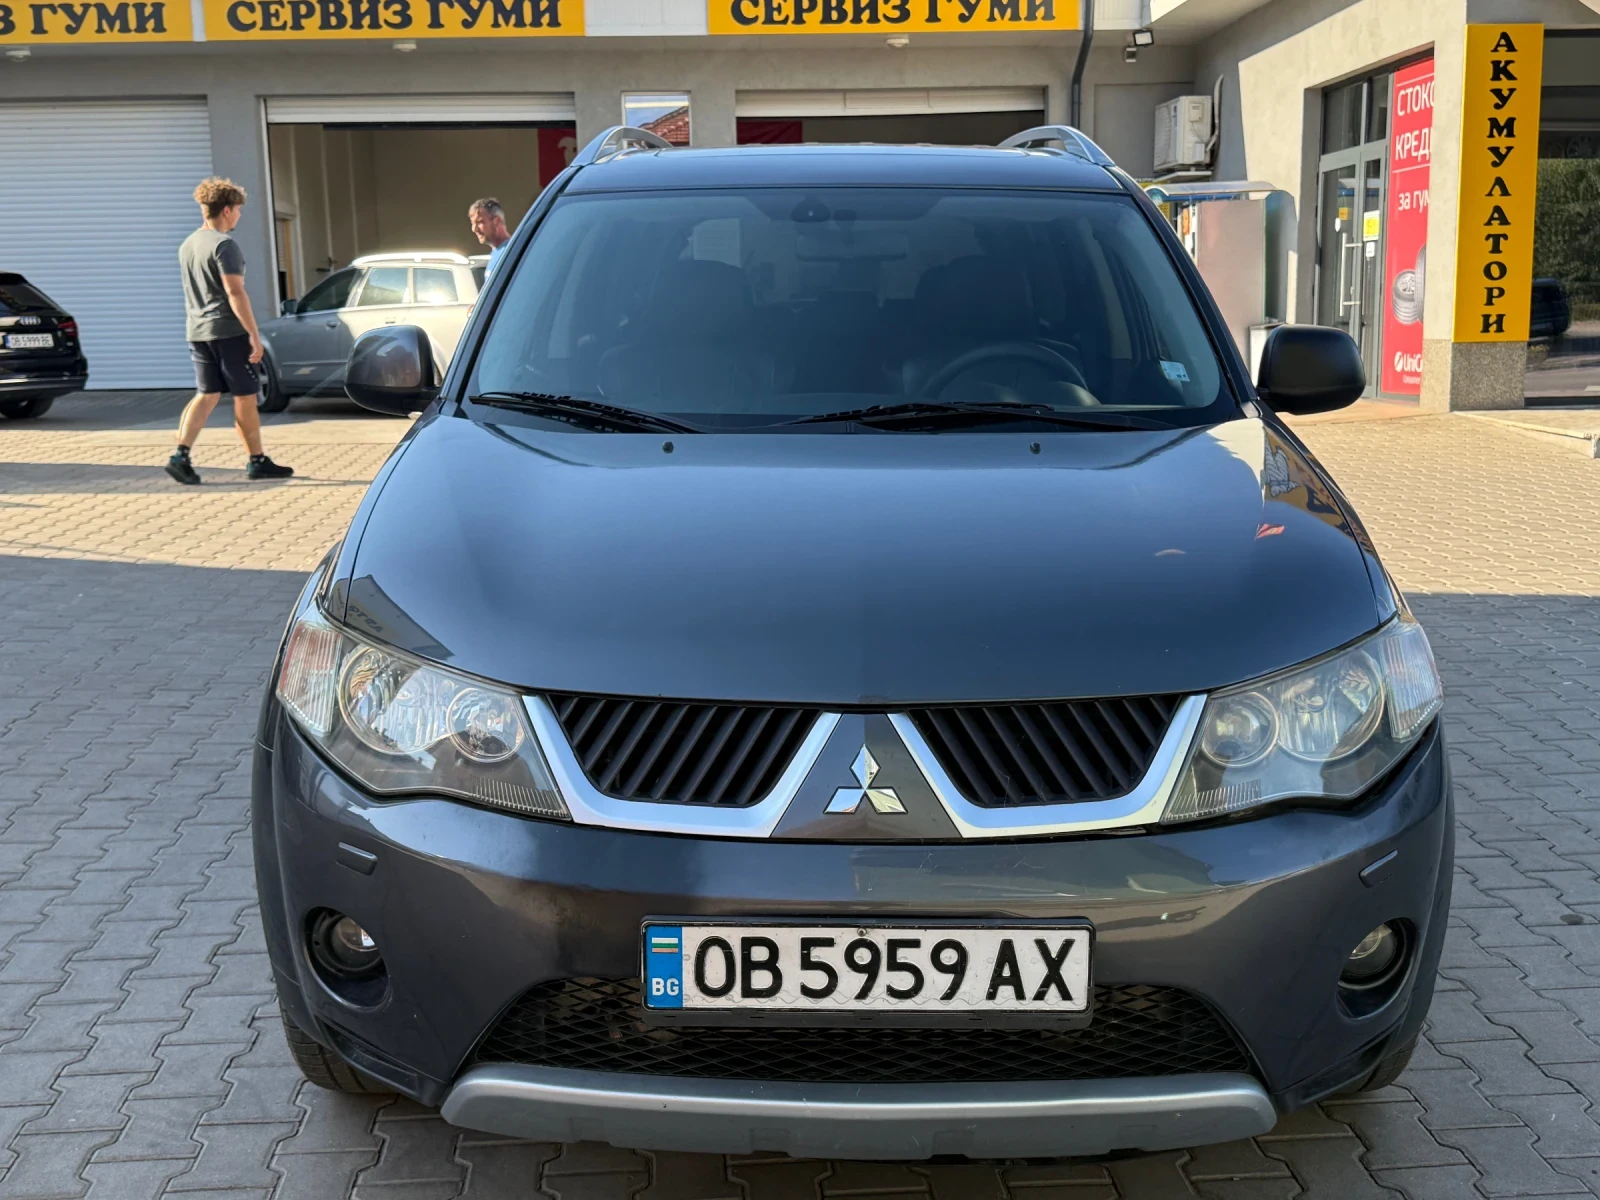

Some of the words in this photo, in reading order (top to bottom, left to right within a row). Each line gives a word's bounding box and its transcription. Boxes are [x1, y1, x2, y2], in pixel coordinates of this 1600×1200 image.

[28, 3, 167, 35] ГУМИ
[227, 0, 413, 32] СЕРВИЗ
[426, 0, 562, 30] ГУМИ
[731, 0, 911, 26] СЕРВИЗ
[925, 0, 1056, 23] ГУМИ
[1480, 31, 1518, 334] АКУМУЛАТОРИ
[1398, 192, 1410, 211] за
[800, 935, 969, 1000] 5959
[651, 977, 680, 996] BG
